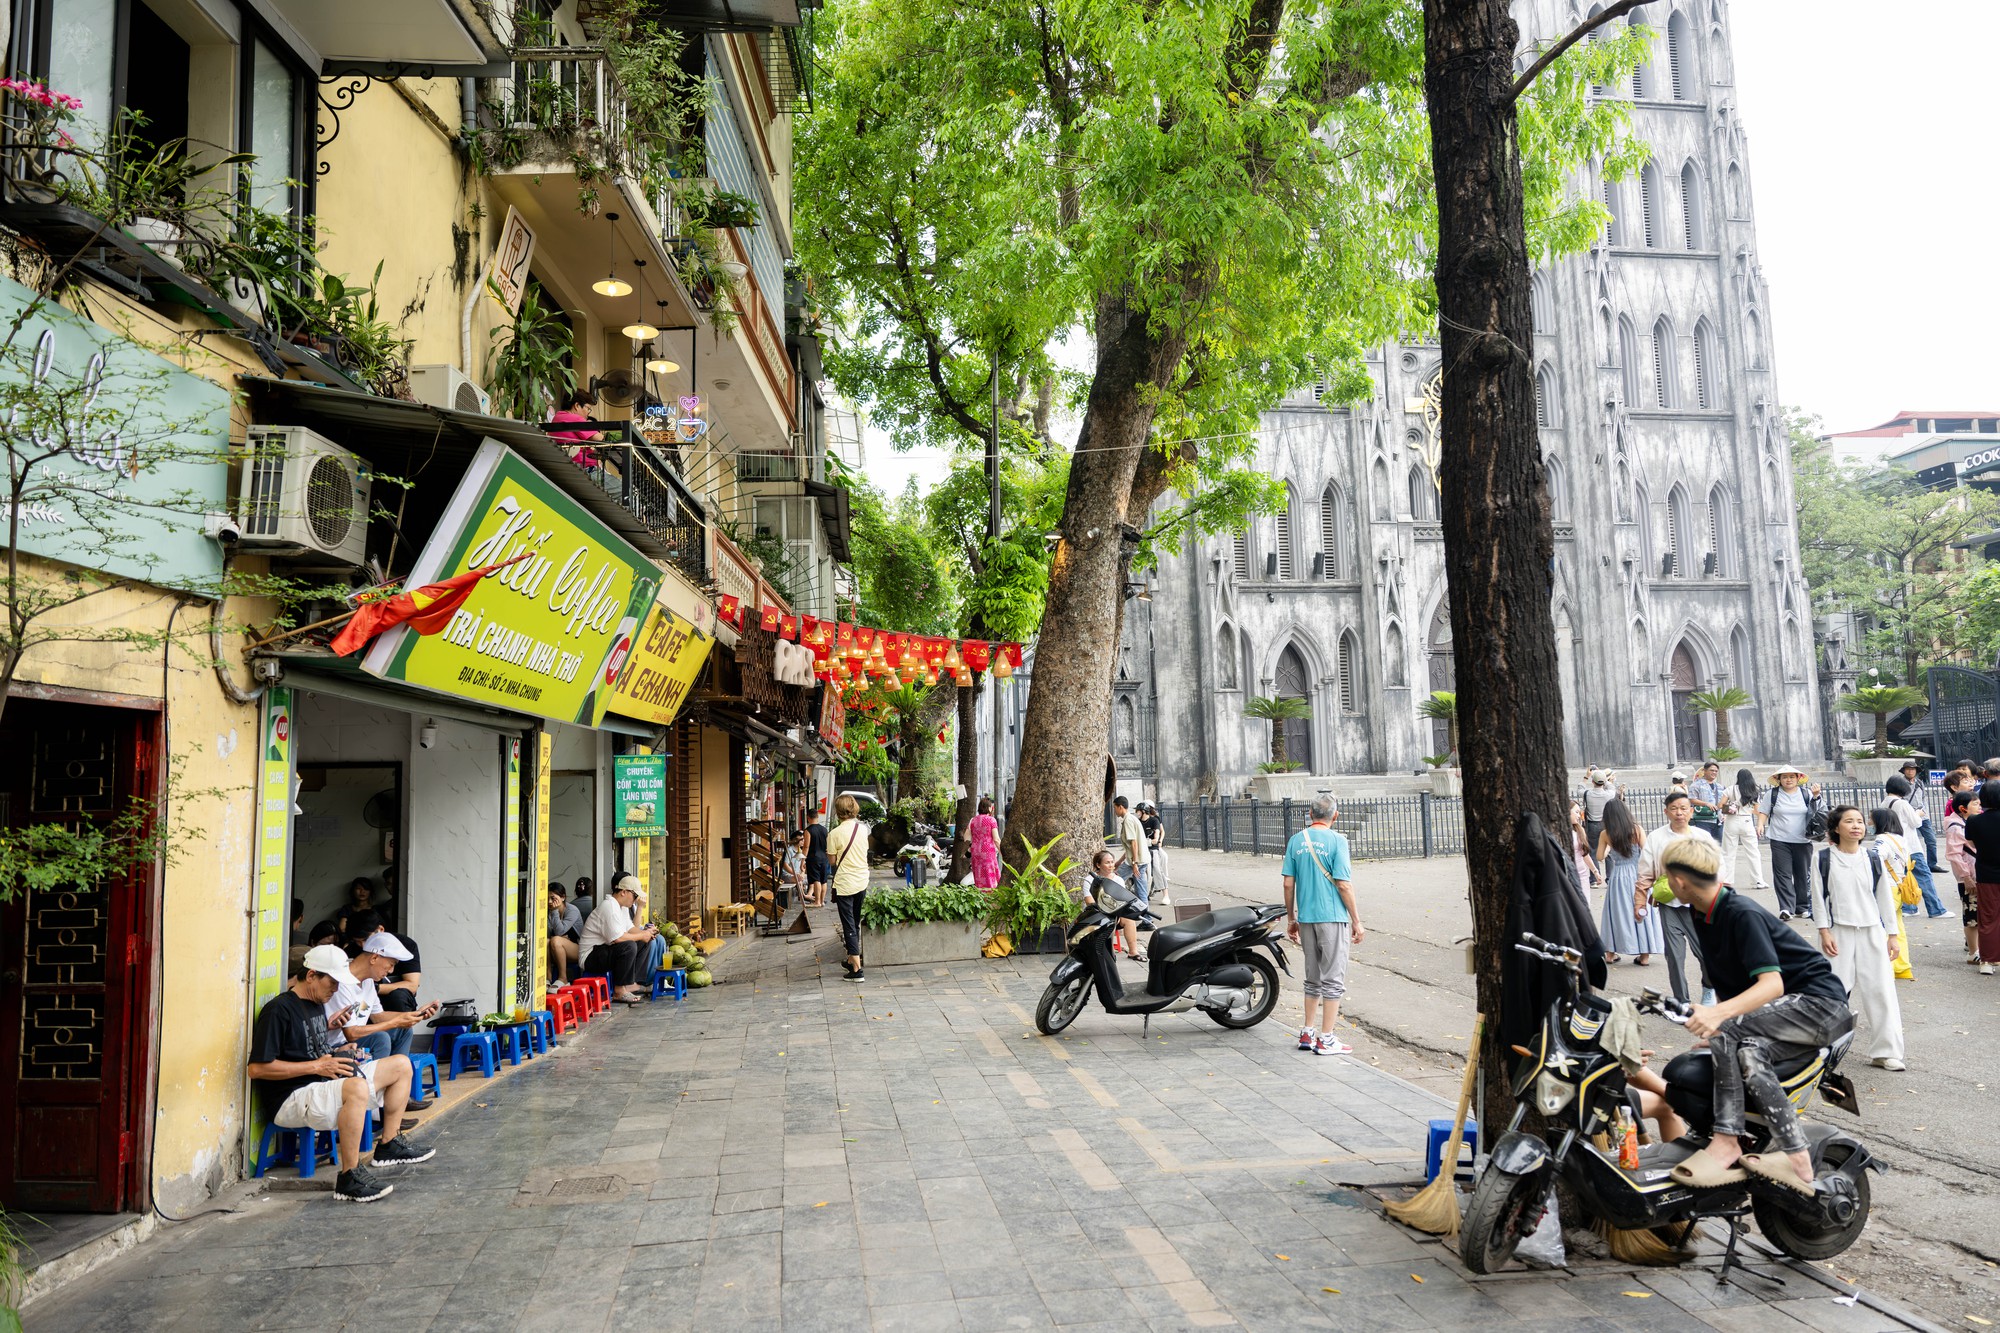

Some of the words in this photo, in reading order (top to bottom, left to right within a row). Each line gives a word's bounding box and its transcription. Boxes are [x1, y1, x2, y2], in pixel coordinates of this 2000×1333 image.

[646, 406, 677, 416] OPEN
[667, 417, 677, 431] 2
[549, 546, 620, 639] Coffee
[442, 608, 484, 650] TRÀ
[476, 622, 534, 667] CHANH
[525, 641, 561, 677] NHÀ
[488, 672, 506, 690] SỐ
[499, 680, 507, 692] 2
[504, 679, 523, 697] NHÀ
[518, 683, 543, 702] CHUNG
[630, 667, 686, 710] CHANH
[637, 778, 648, 789] XÔI
